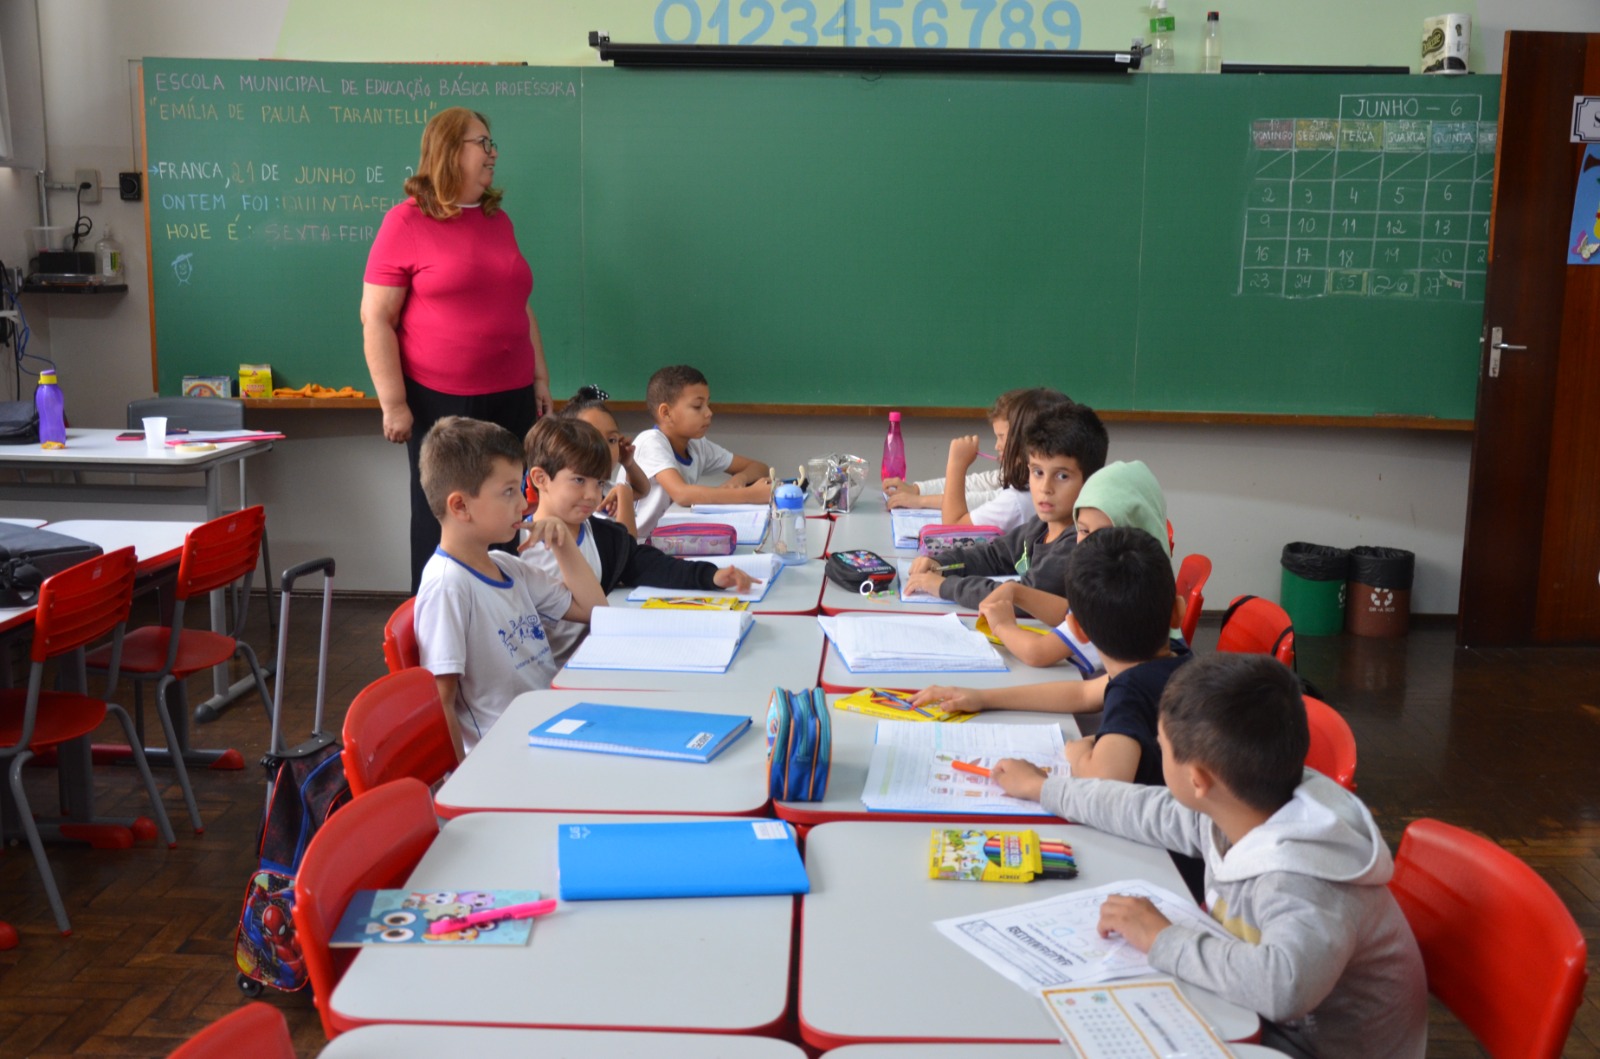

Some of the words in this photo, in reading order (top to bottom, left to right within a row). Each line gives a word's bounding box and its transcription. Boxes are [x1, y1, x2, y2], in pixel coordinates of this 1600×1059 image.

[155, 73, 225, 92] ESCOLA
[240, 74, 332, 94] MUNICIPAL
[341, 78, 359, 96] DE
[366, 76, 431, 100] EDUCAÇÃO
[439, 72, 489, 97] BÁSICA
[495, 80, 577, 98] PROFESSORA
[229, 103, 245, 121] DE
[262, 105, 310, 124] PAULA
[1352, 98, 1419, 118] JUNHO
[1450, 99, 1463, 117] 6
[1252, 130, 1293, 141] DOMINGO
[1297, 129, 1335, 141] SEGUNDA
[1341, 130, 1375, 143] TERÇA
[1433, 132, 1474, 145] QUINTA
[261, 163, 281, 181] DE
[295, 165, 356, 184] JUNHO
[366, 165, 385, 183] DE
[162, 193, 226, 211] ONTEM
[1261, 187, 1276, 203] 2
[1304, 188, 1313, 204] 3
[1349, 187, 1358, 204] 4
[1394, 186, 1405, 204] 5
[1443, 184, 1452, 201] 6
[166, 222, 212, 240] HOJE
[1260, 213, 1271, 228] 9
[1297, 217, 1316, 233] 10
[1342, 217, 1356, 234] 11
[1386, 219, 1407, 235] 12
[1434, 219, 1451, 236] 13
[1255, 245, 1270, 262] 16
[1296, 247, 1312, 264] 17
[1338, 249, 1354, 268] 18
[1249, 272, 1271, 289] 23
[1294, 273, 1312, 289] 24
[1423, 276, 1442, 297] 27
